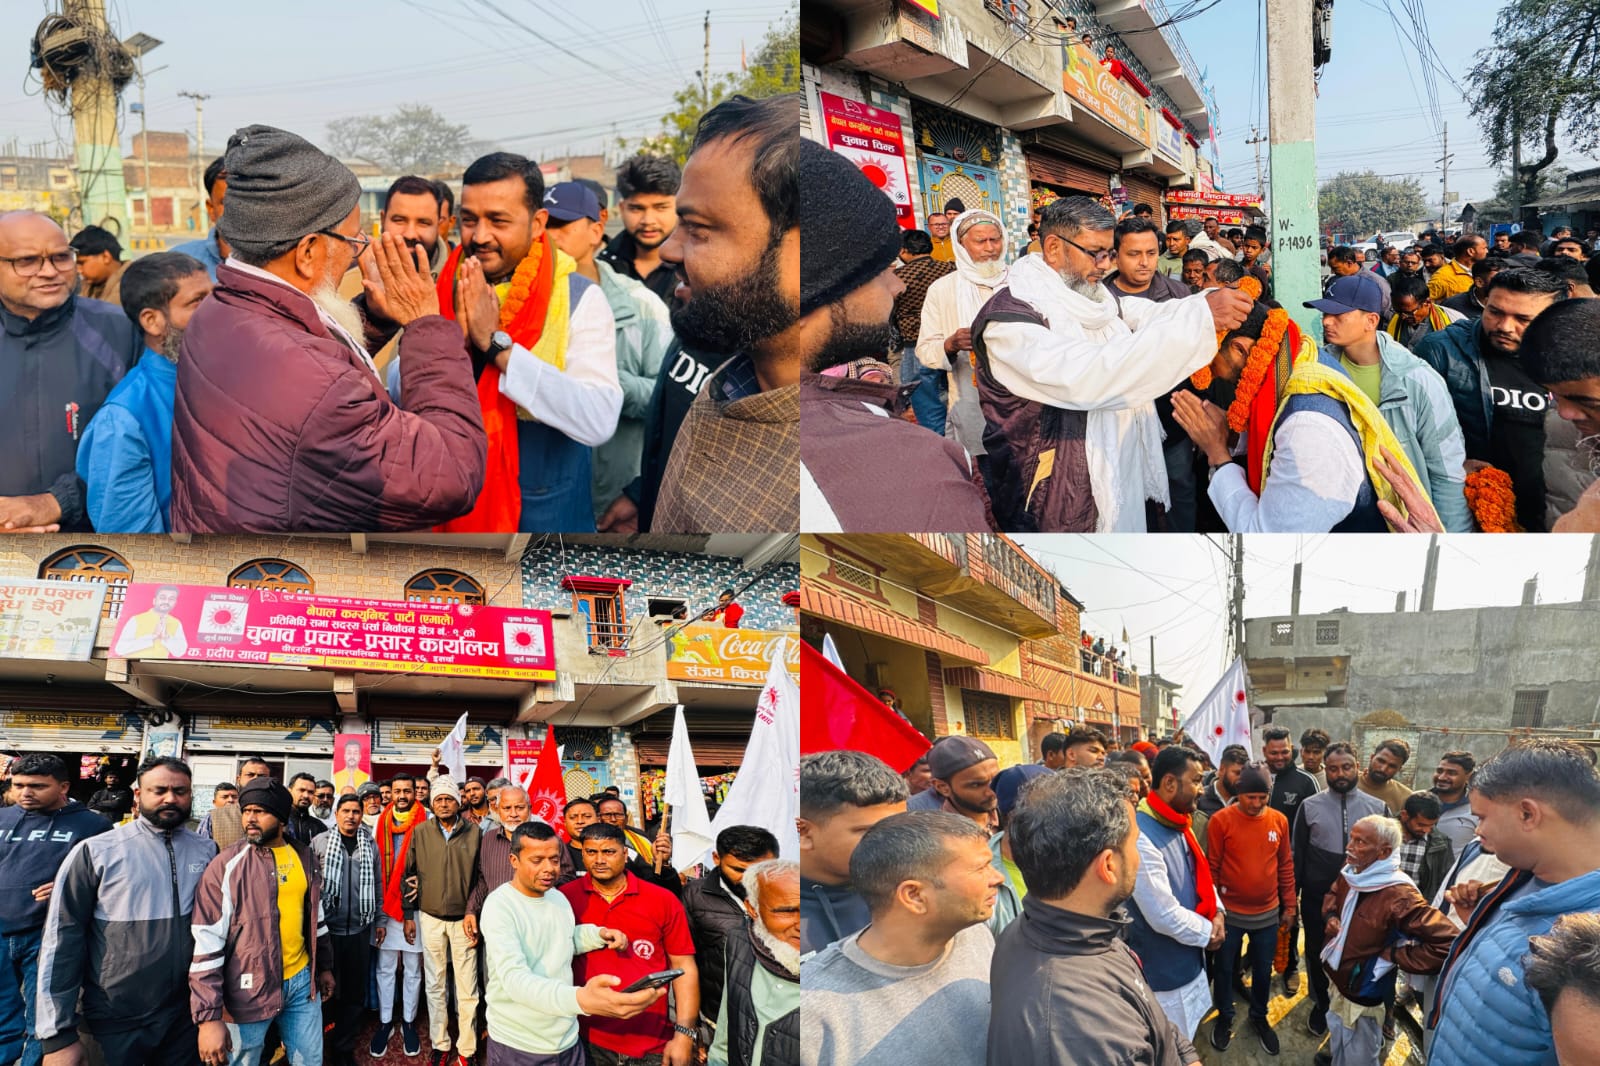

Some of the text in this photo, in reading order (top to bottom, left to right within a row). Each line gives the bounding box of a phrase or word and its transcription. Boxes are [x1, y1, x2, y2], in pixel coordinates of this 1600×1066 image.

[840, 134, 869, 148] चुनाव
[668, 350, 714, 395] DI
[1490, 386, 1549, 411] DIO
[269, 614, 307, 626] प्रतिनिधि
[310, 619, 329, 628] सभा
[382, 622, 416, 634] निर्वाचन
[418, 625, 435, 636] क्षेत्र
[463, 627, 476, 638] को
[306, 604, 337, 618] नेपाल
[394, 611, 416, 623] पार्टी
[419, 613, 454, 626] (एमाले)
[246, 625, 297, 646] चुनाव
[419, 636, 499, 657] कार्यालय
[206, 646, 235, 659] प्रदीप
[238, 649, 268, 661] यादव
[684, 664, 724, 678] संजय
